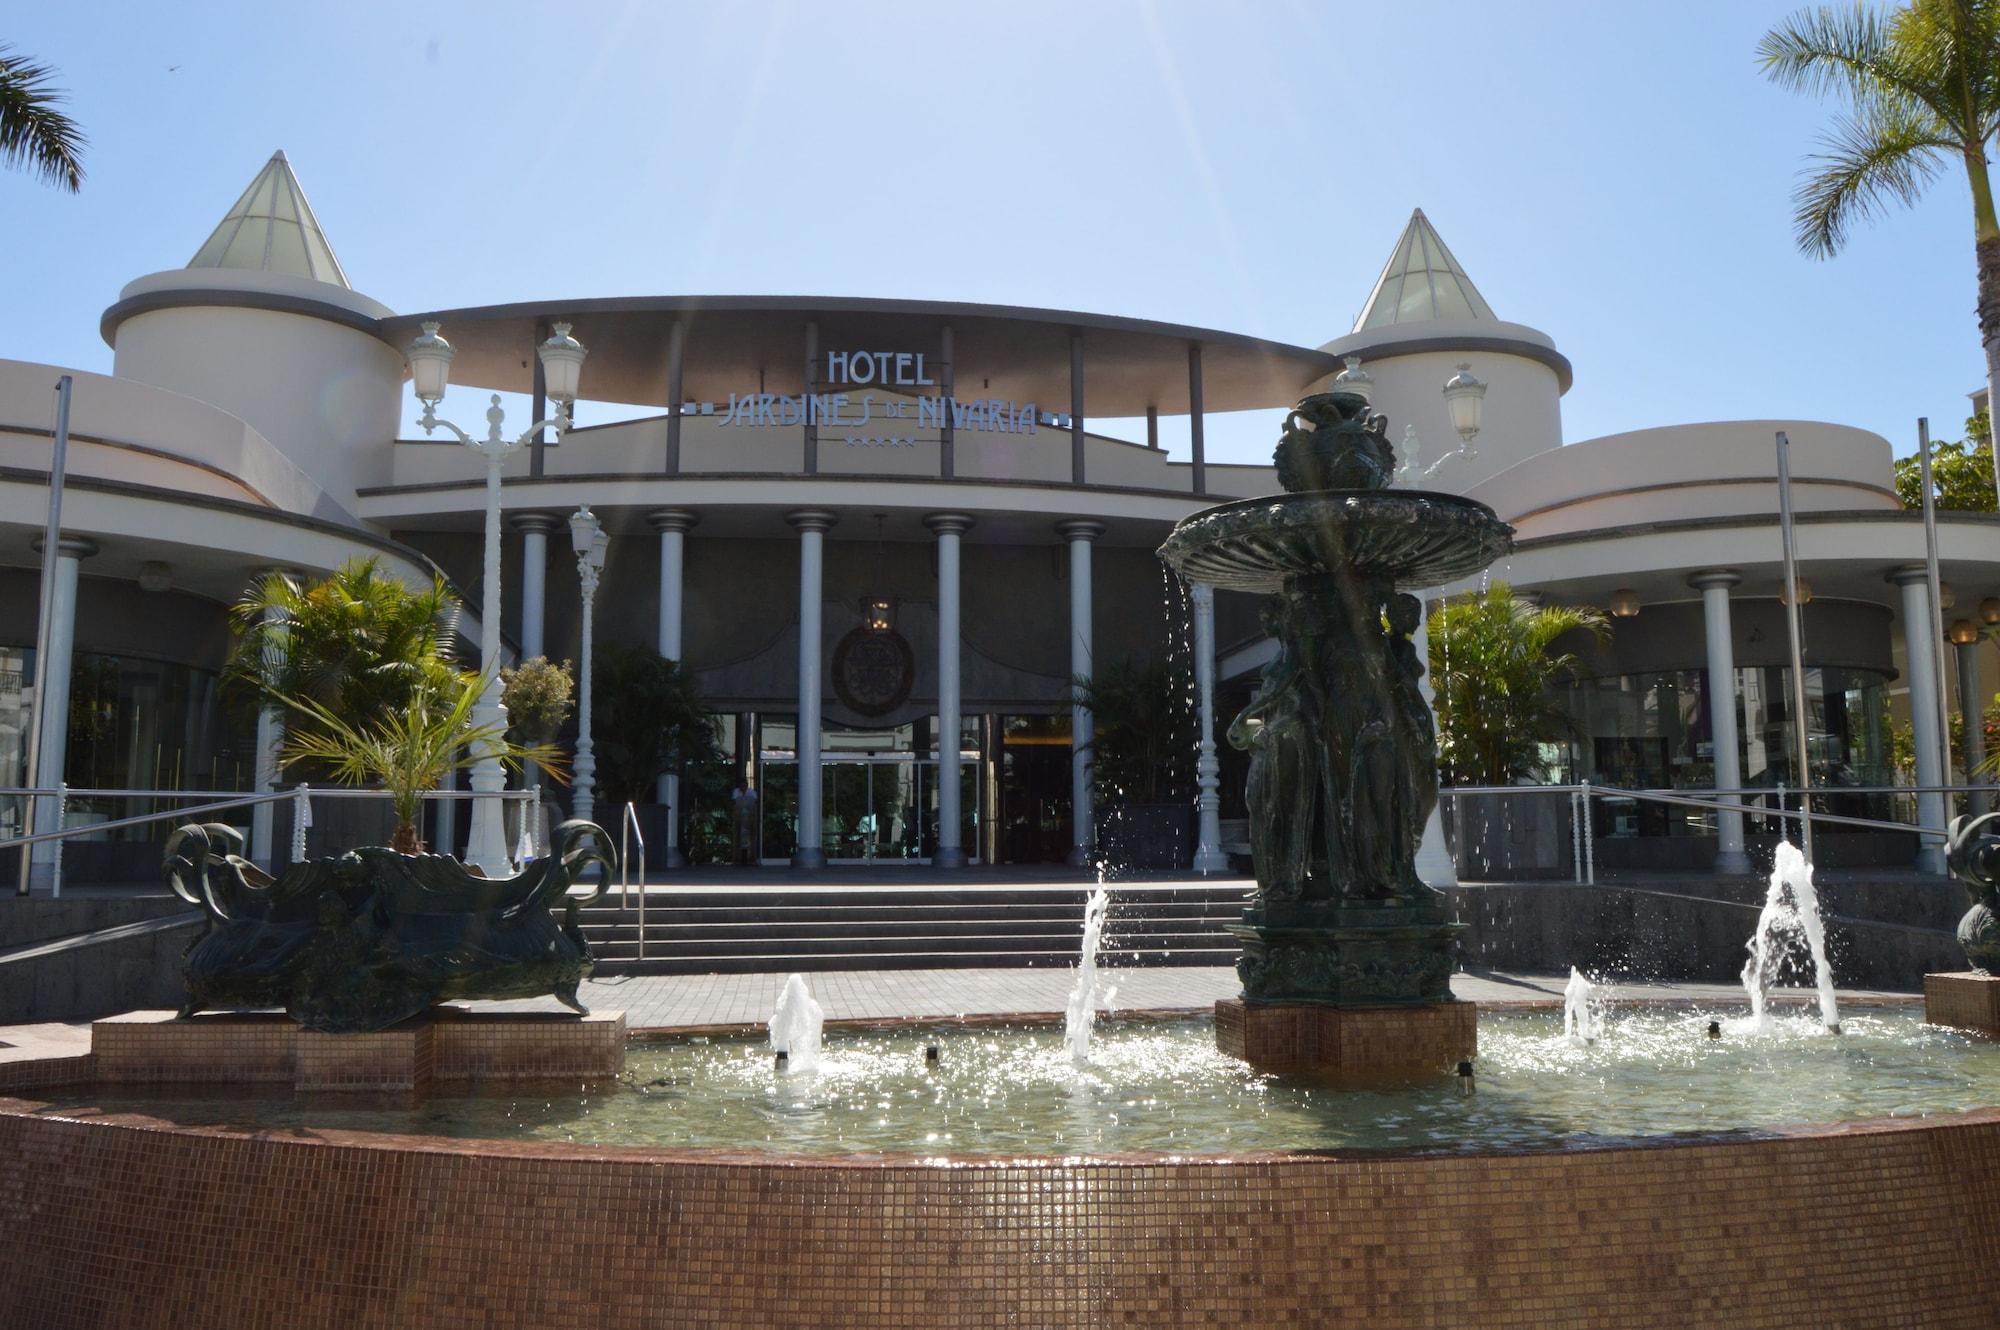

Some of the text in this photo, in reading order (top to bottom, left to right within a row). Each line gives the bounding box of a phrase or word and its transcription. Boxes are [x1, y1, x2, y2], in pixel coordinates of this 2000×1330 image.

[828, 351, 934, 386] HOTEL
[719, 392, 1037, 434] JARDINES DE NIVARIA
